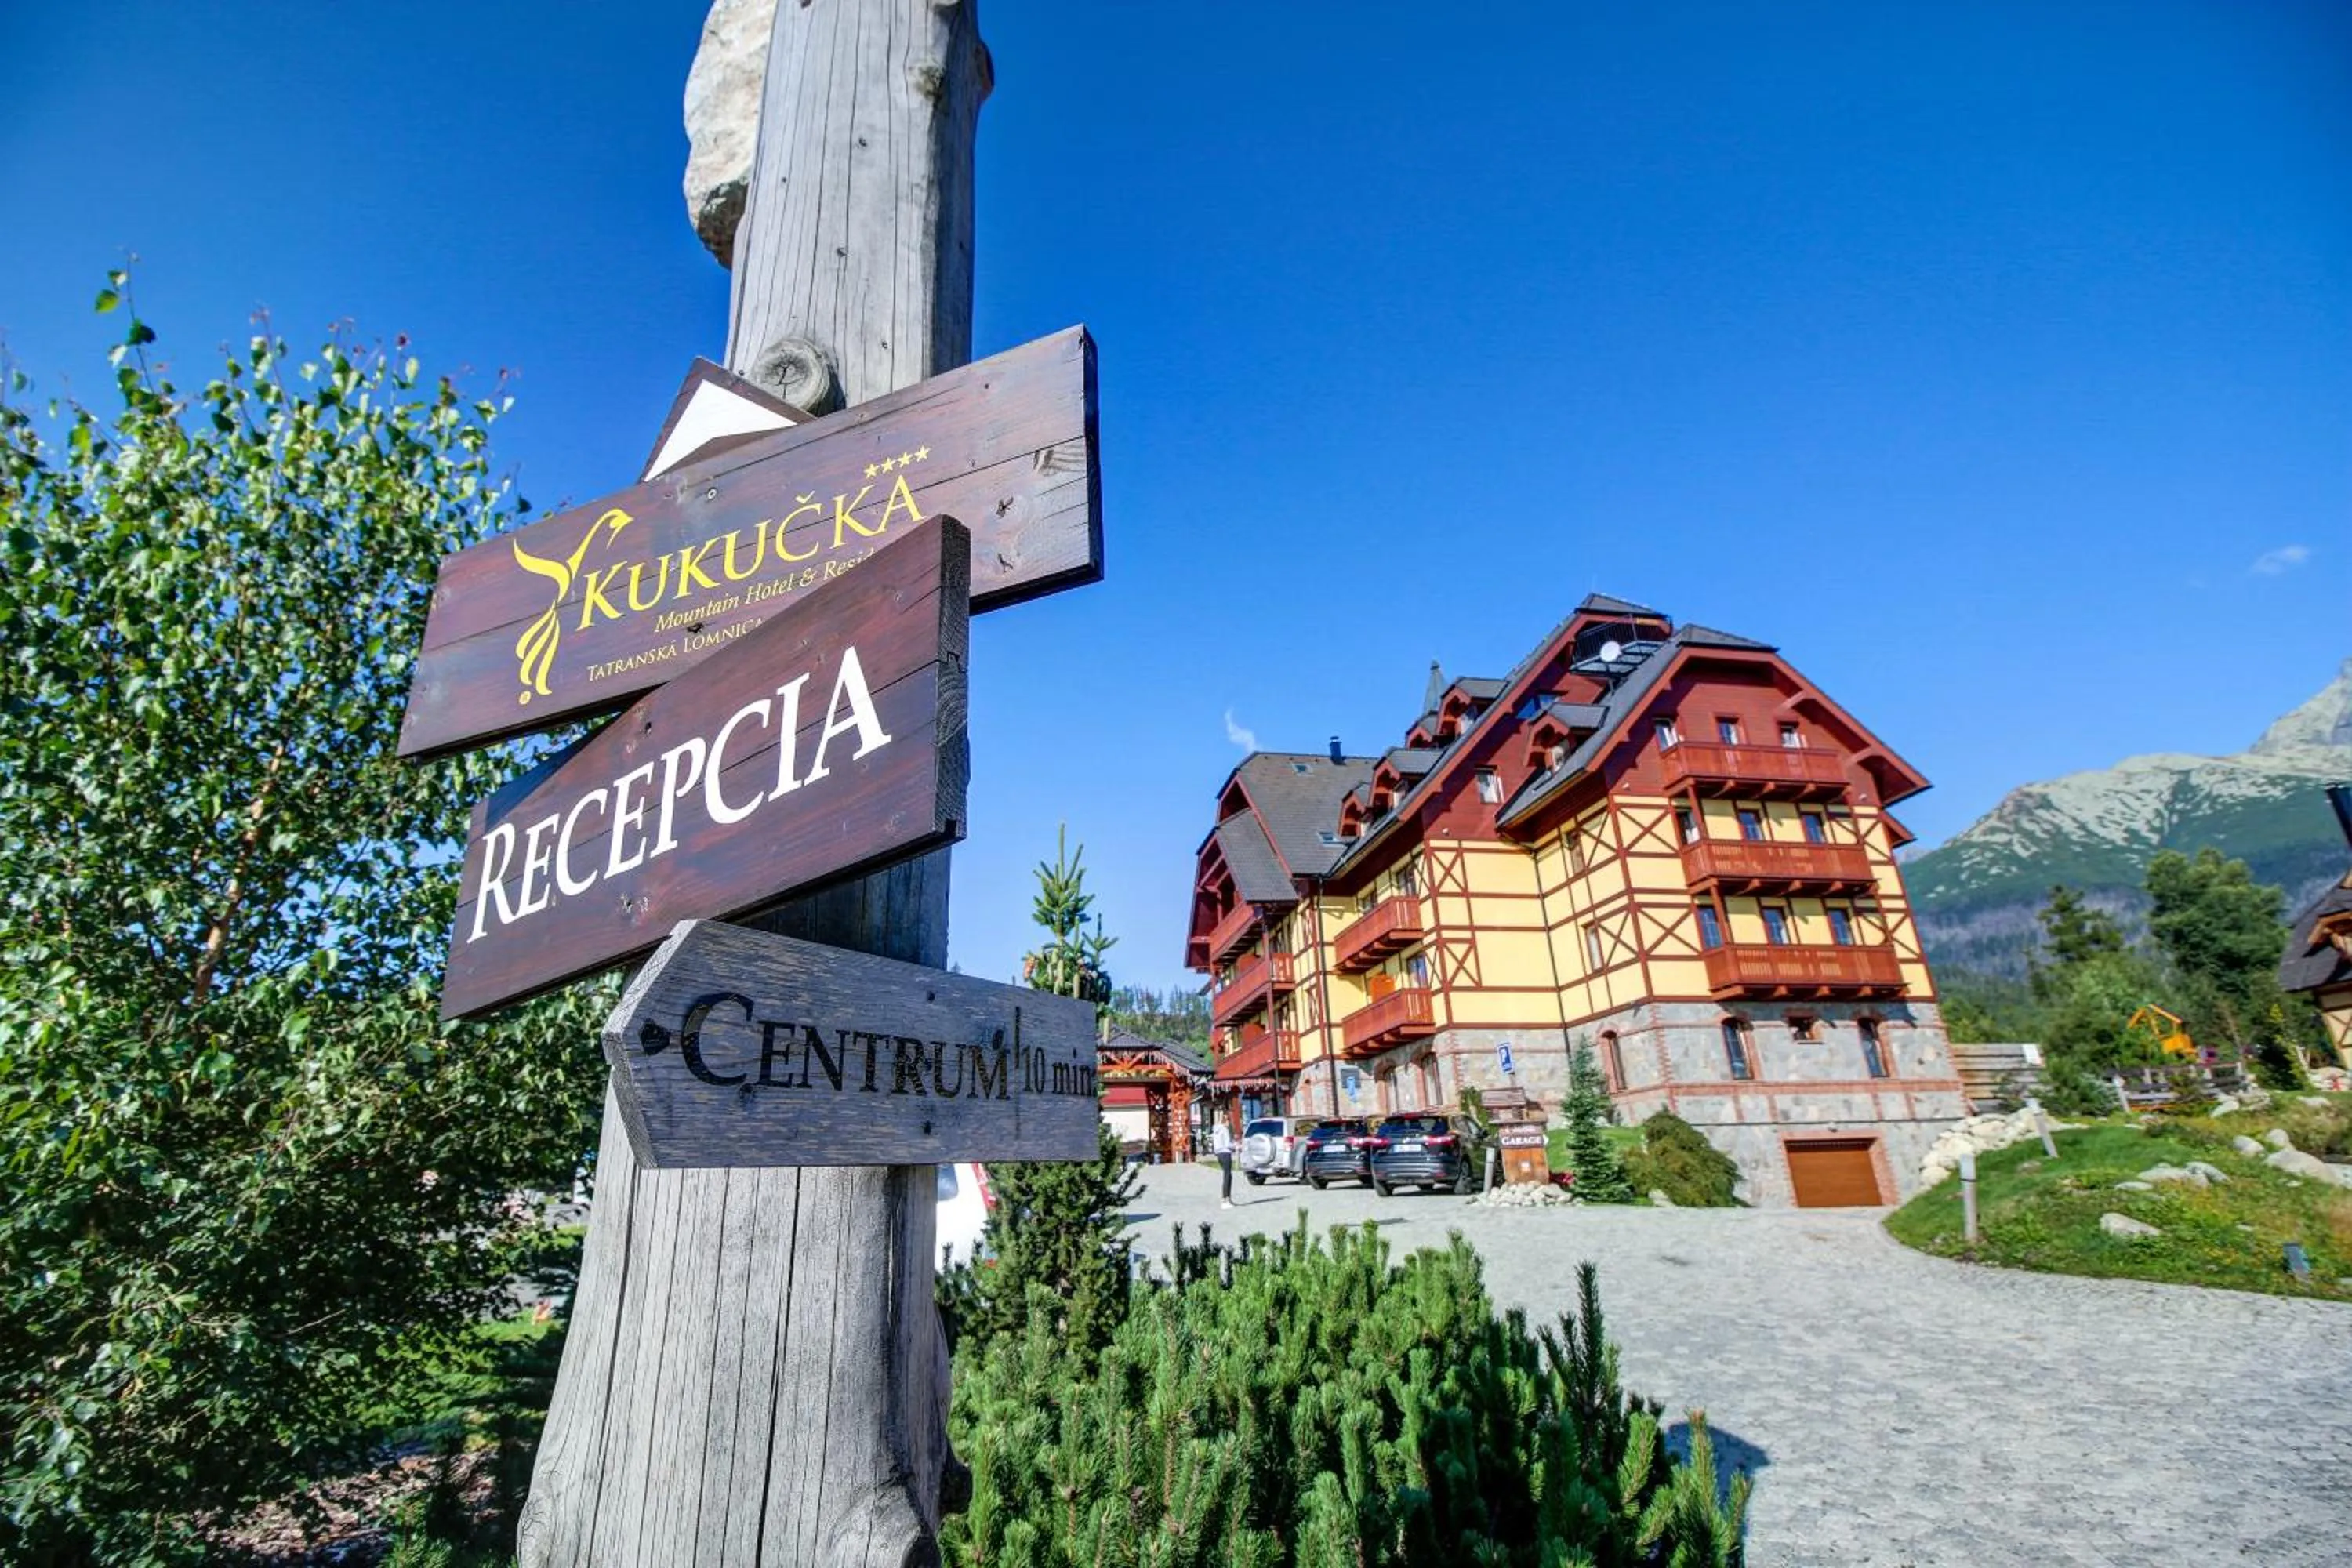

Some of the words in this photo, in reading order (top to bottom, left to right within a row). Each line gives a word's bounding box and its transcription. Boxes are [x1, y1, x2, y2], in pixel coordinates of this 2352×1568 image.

[575, 474, 927, 630] KUKUČKA
[653, 593, 740, 633] Mountain
[743, 573, 793, 605] Hotel
[796, 568, 815, 587] &
[586, 639, 677, 682] TATRANSKÁ
[467, 645, 891, 944] RECEPCIA
[681, 991, 1011, 1101] CENTRUM
[1021, 1044, 1046, 1095] 10
[1501, 1136, 1541, 1145] GARAGE
